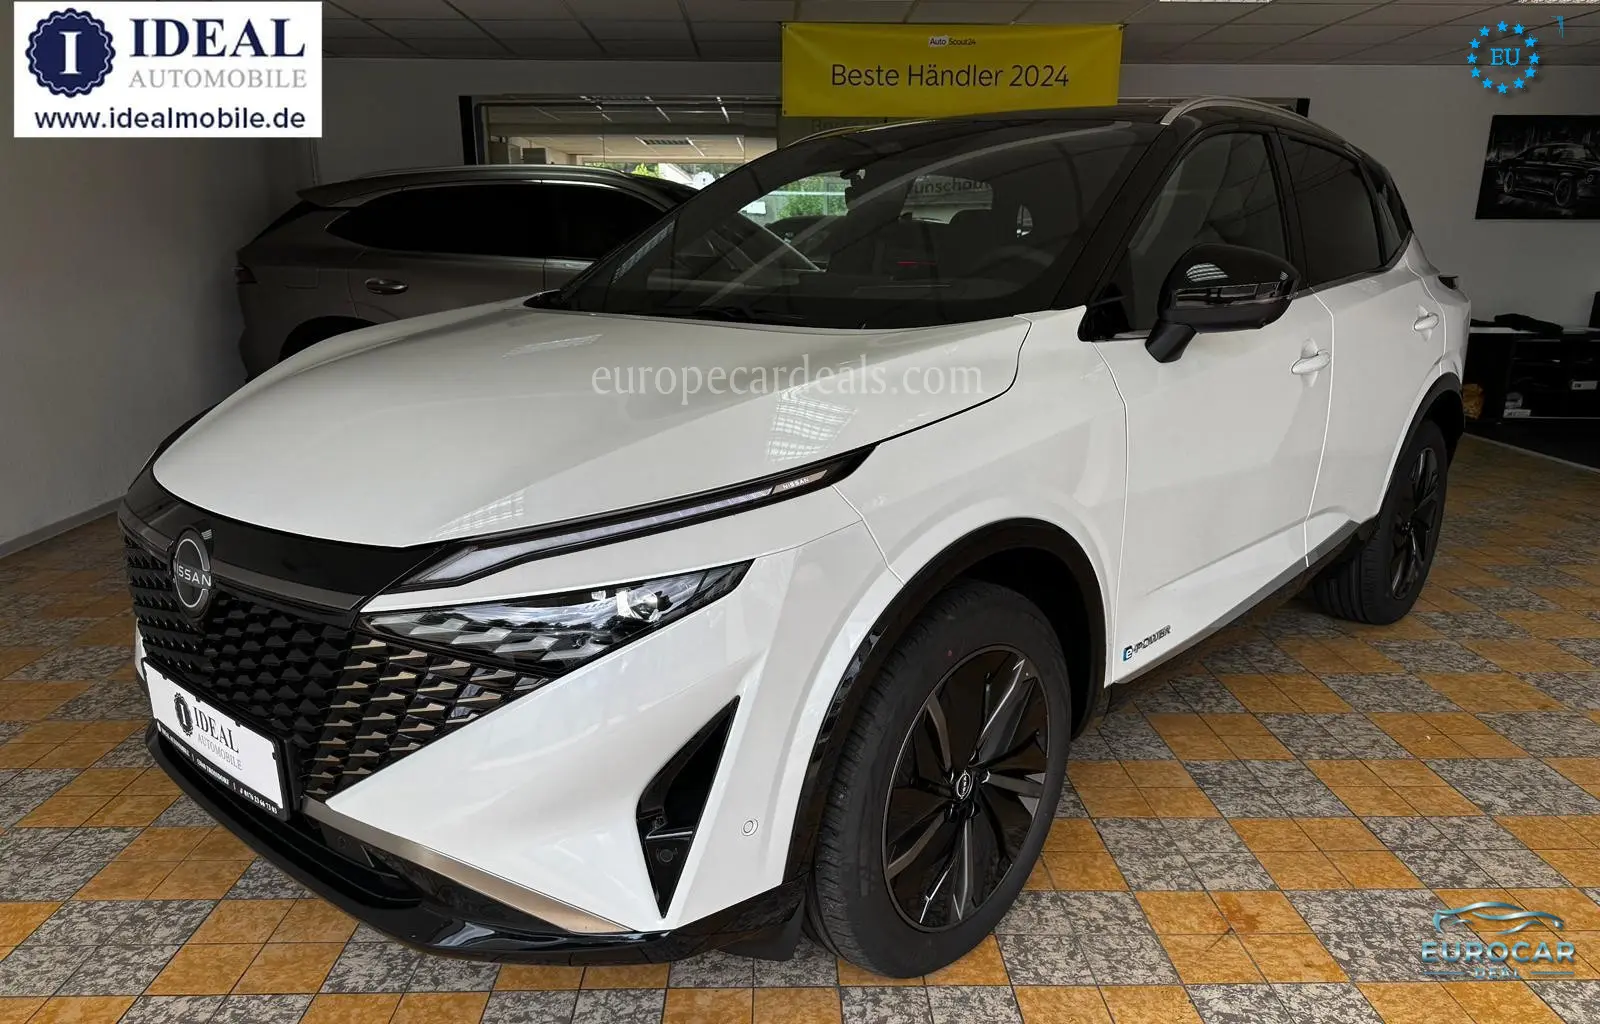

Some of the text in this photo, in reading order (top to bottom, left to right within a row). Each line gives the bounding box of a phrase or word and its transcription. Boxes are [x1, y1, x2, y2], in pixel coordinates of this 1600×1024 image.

[831, 64, 1069, 87] Beste Händler 2024
[782, 477, 809, 489] NISSAN
[193, 706, 239, 753] IDEAL
[198, 733, 243, 770] AUTOMOBILE
